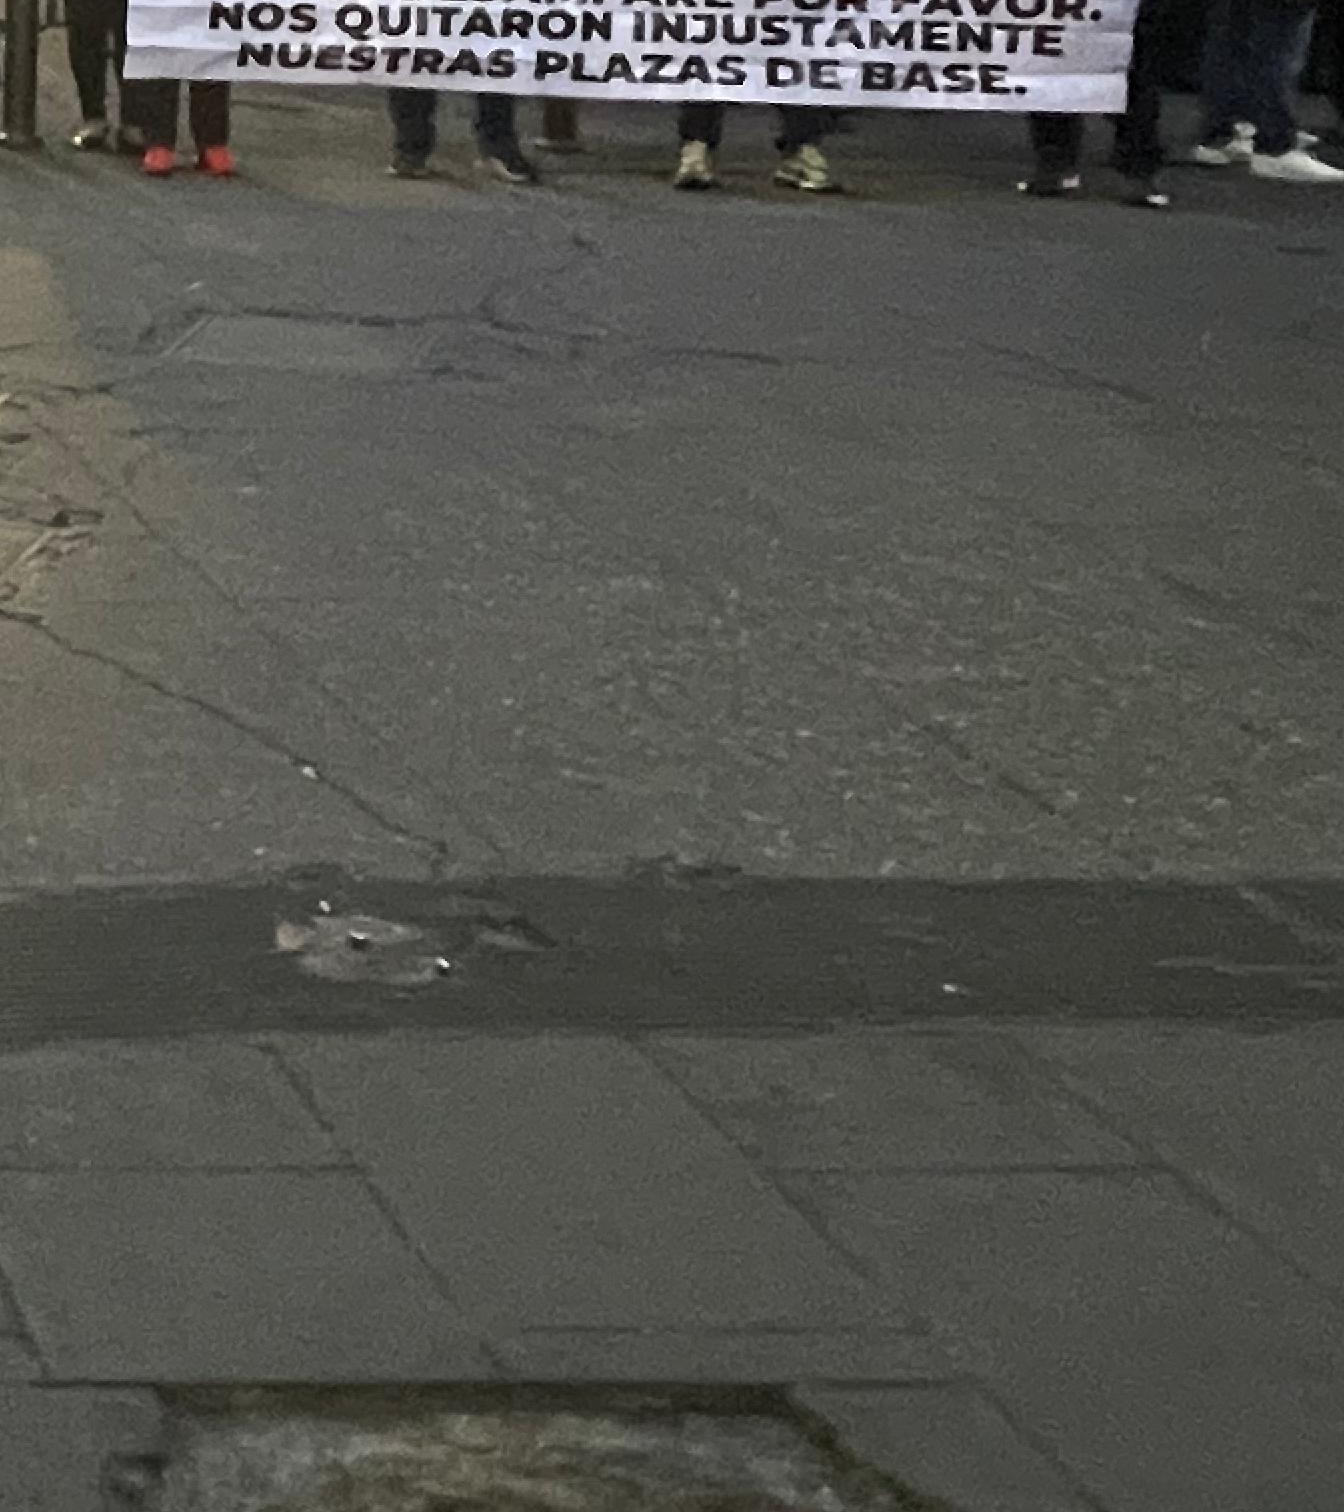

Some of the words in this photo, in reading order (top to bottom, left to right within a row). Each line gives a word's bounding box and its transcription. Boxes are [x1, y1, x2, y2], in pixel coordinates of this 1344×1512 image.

[209, 1, 317, 33] NOS
[334, 3, 612, 43] QUITARON
[632, 10, 1064, 56] INJUSTAMENTE
[237, 43, 516, 78] NUESTRAS
[534, 50, 747, 86] PLAZAS
[766, 57, 842, 89] DE
[861, 61, 1028, 95] BASE.
